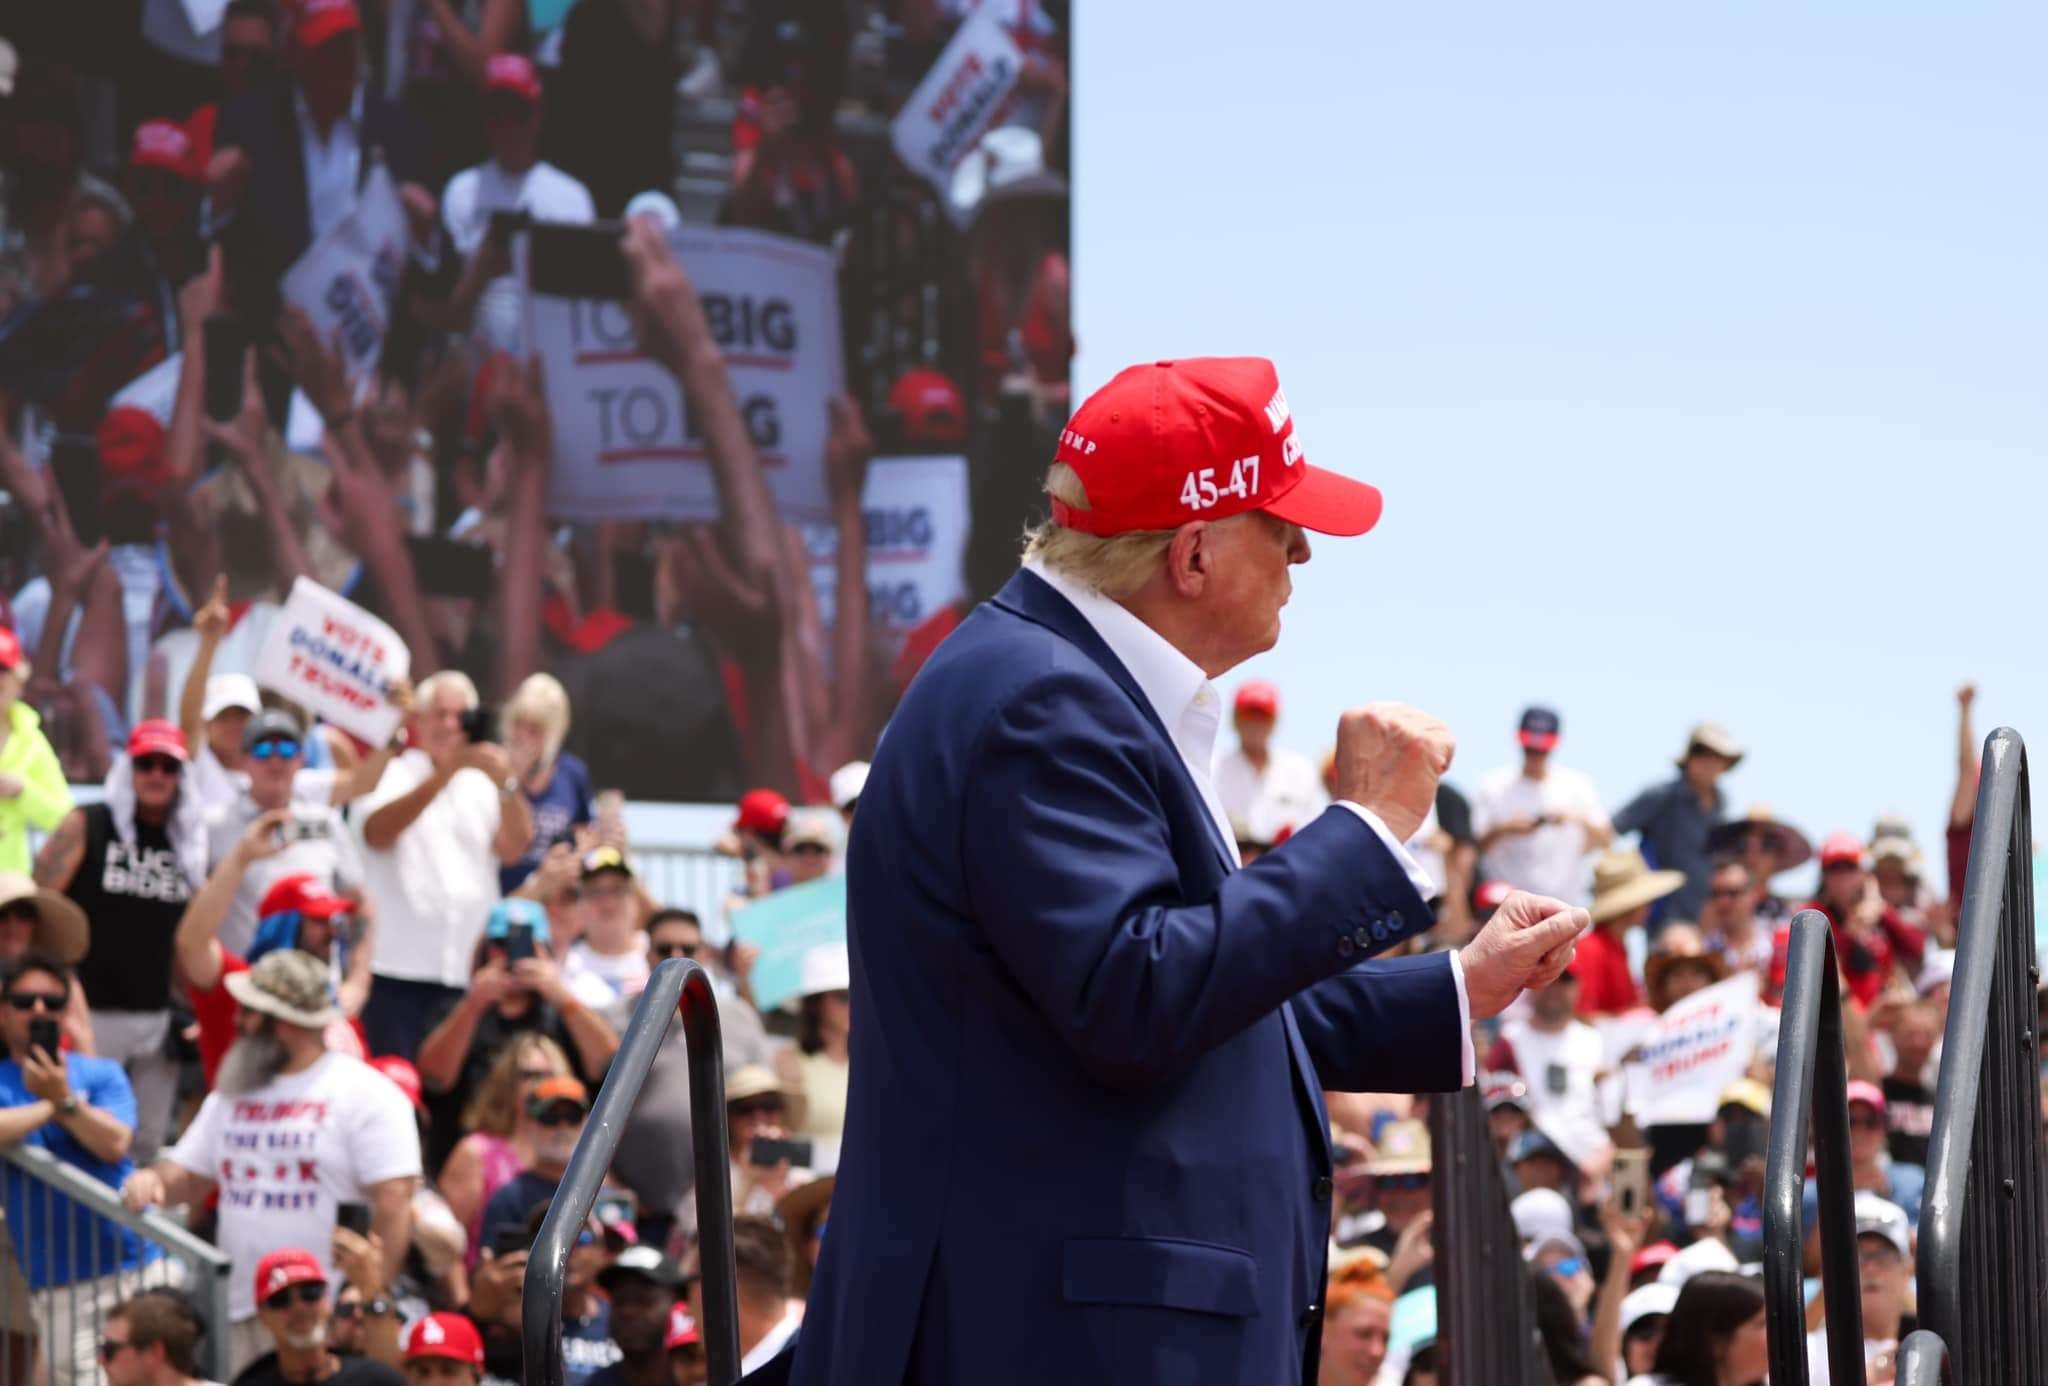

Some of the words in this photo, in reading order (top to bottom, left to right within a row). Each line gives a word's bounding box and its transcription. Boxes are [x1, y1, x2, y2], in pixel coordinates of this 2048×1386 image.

[703, 294, 797, 352] BIG
[586, 385, 669, 447] TO
[1180, 455, 1260, 511] 45-47
[322, 615, 386, 666] VOTE
[288, 655, 377, 711] TRUMP
[1653, 1041, 1730, 1078] TRUMP
